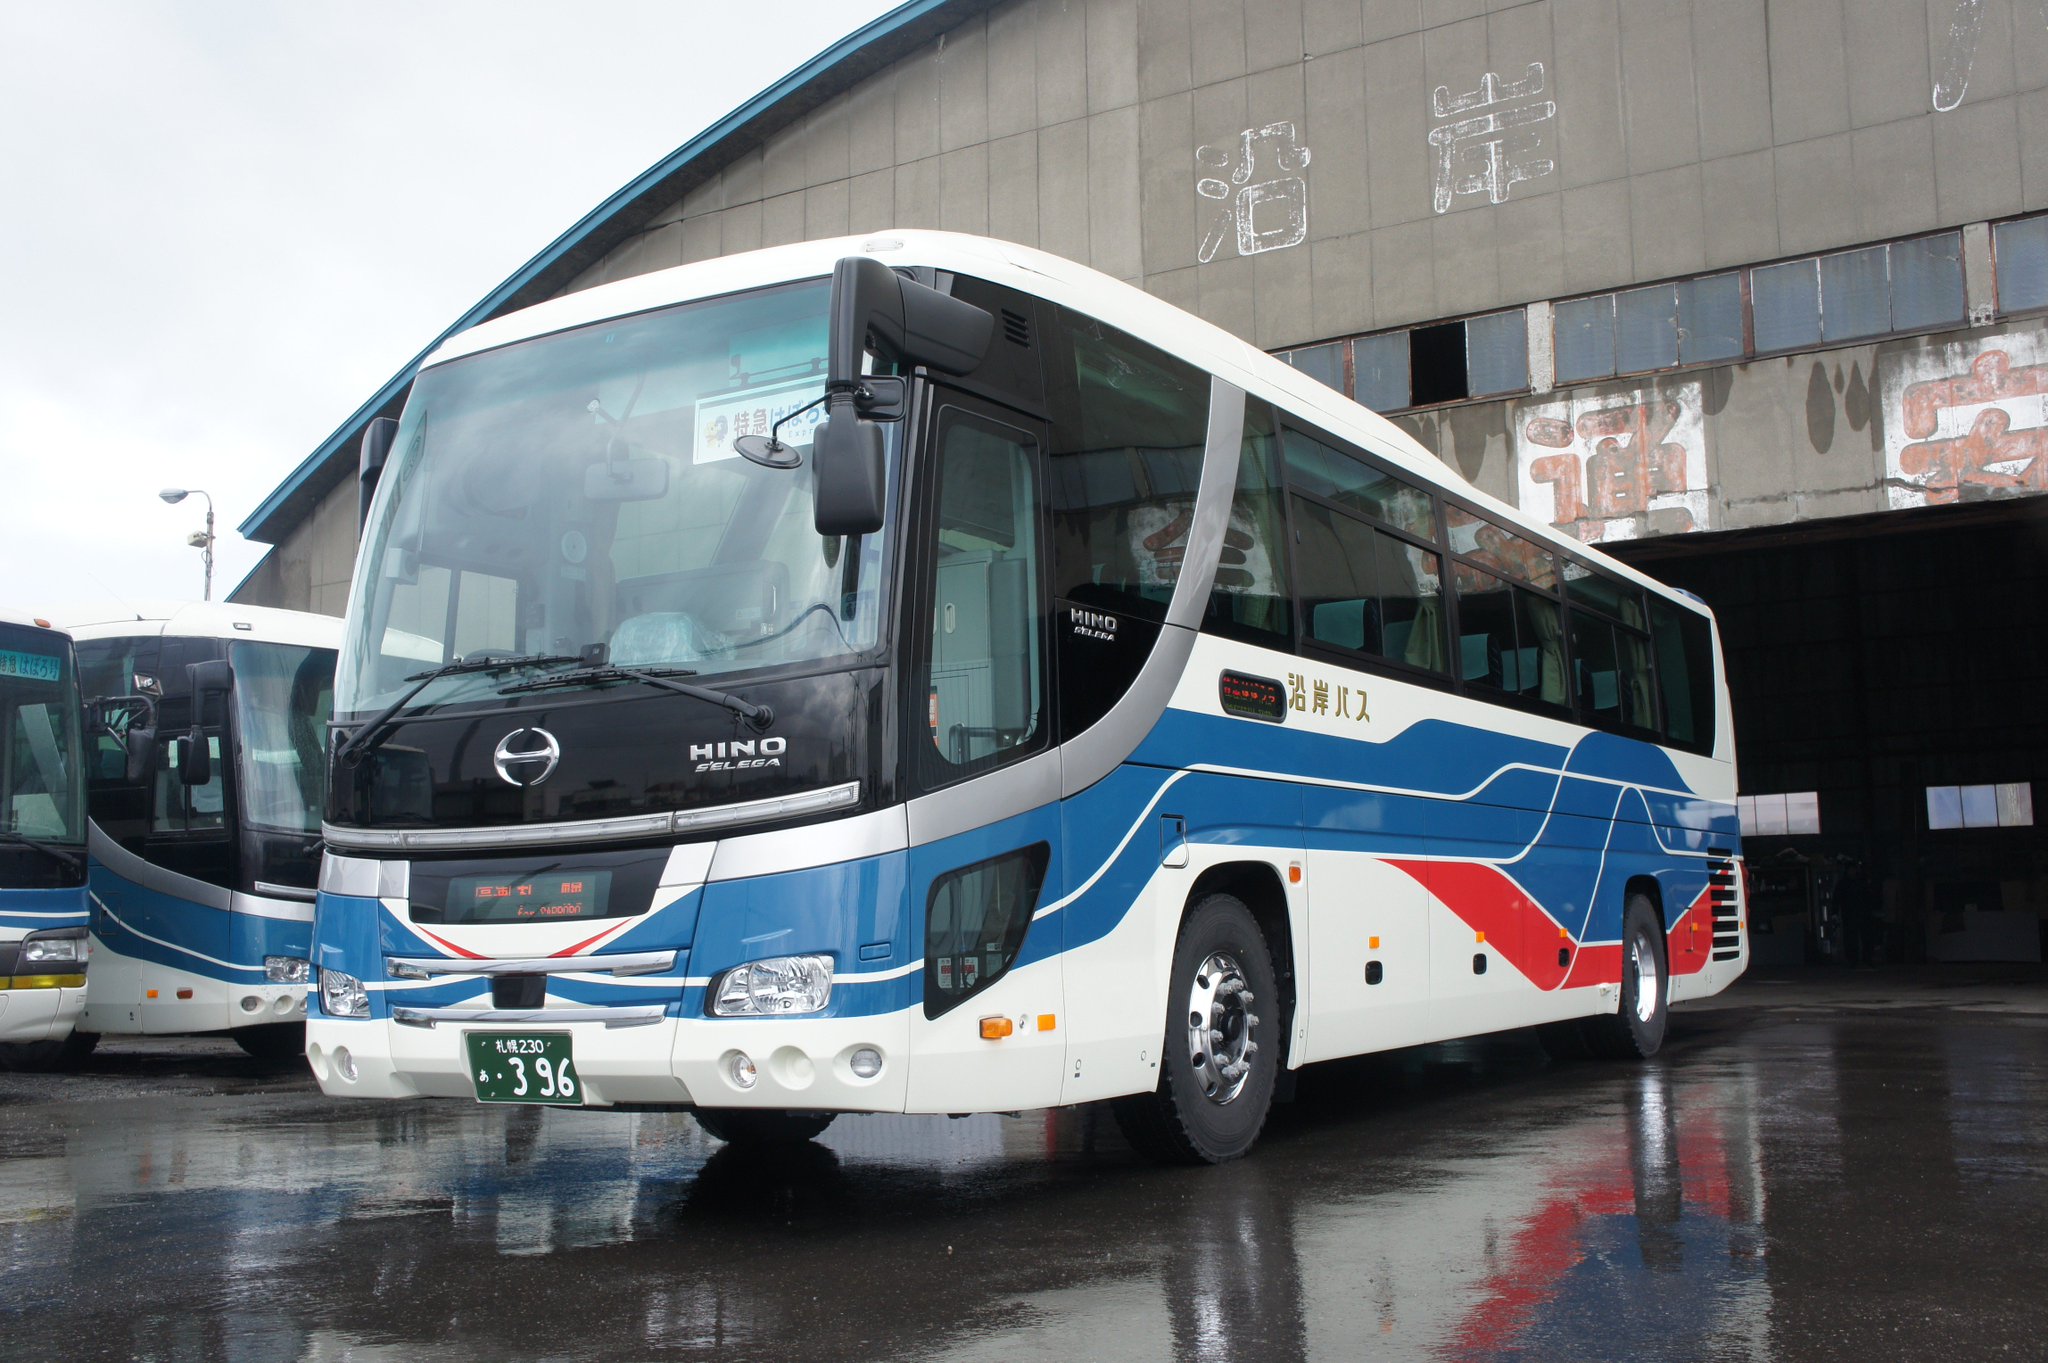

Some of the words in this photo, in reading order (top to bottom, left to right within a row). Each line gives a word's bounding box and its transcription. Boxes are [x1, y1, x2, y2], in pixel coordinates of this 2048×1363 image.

[1071, 607, 1118, 633] HINO
[1288, 672, 1370, 723] 沿岸バス
[689, 736, 787, 761] HINO
